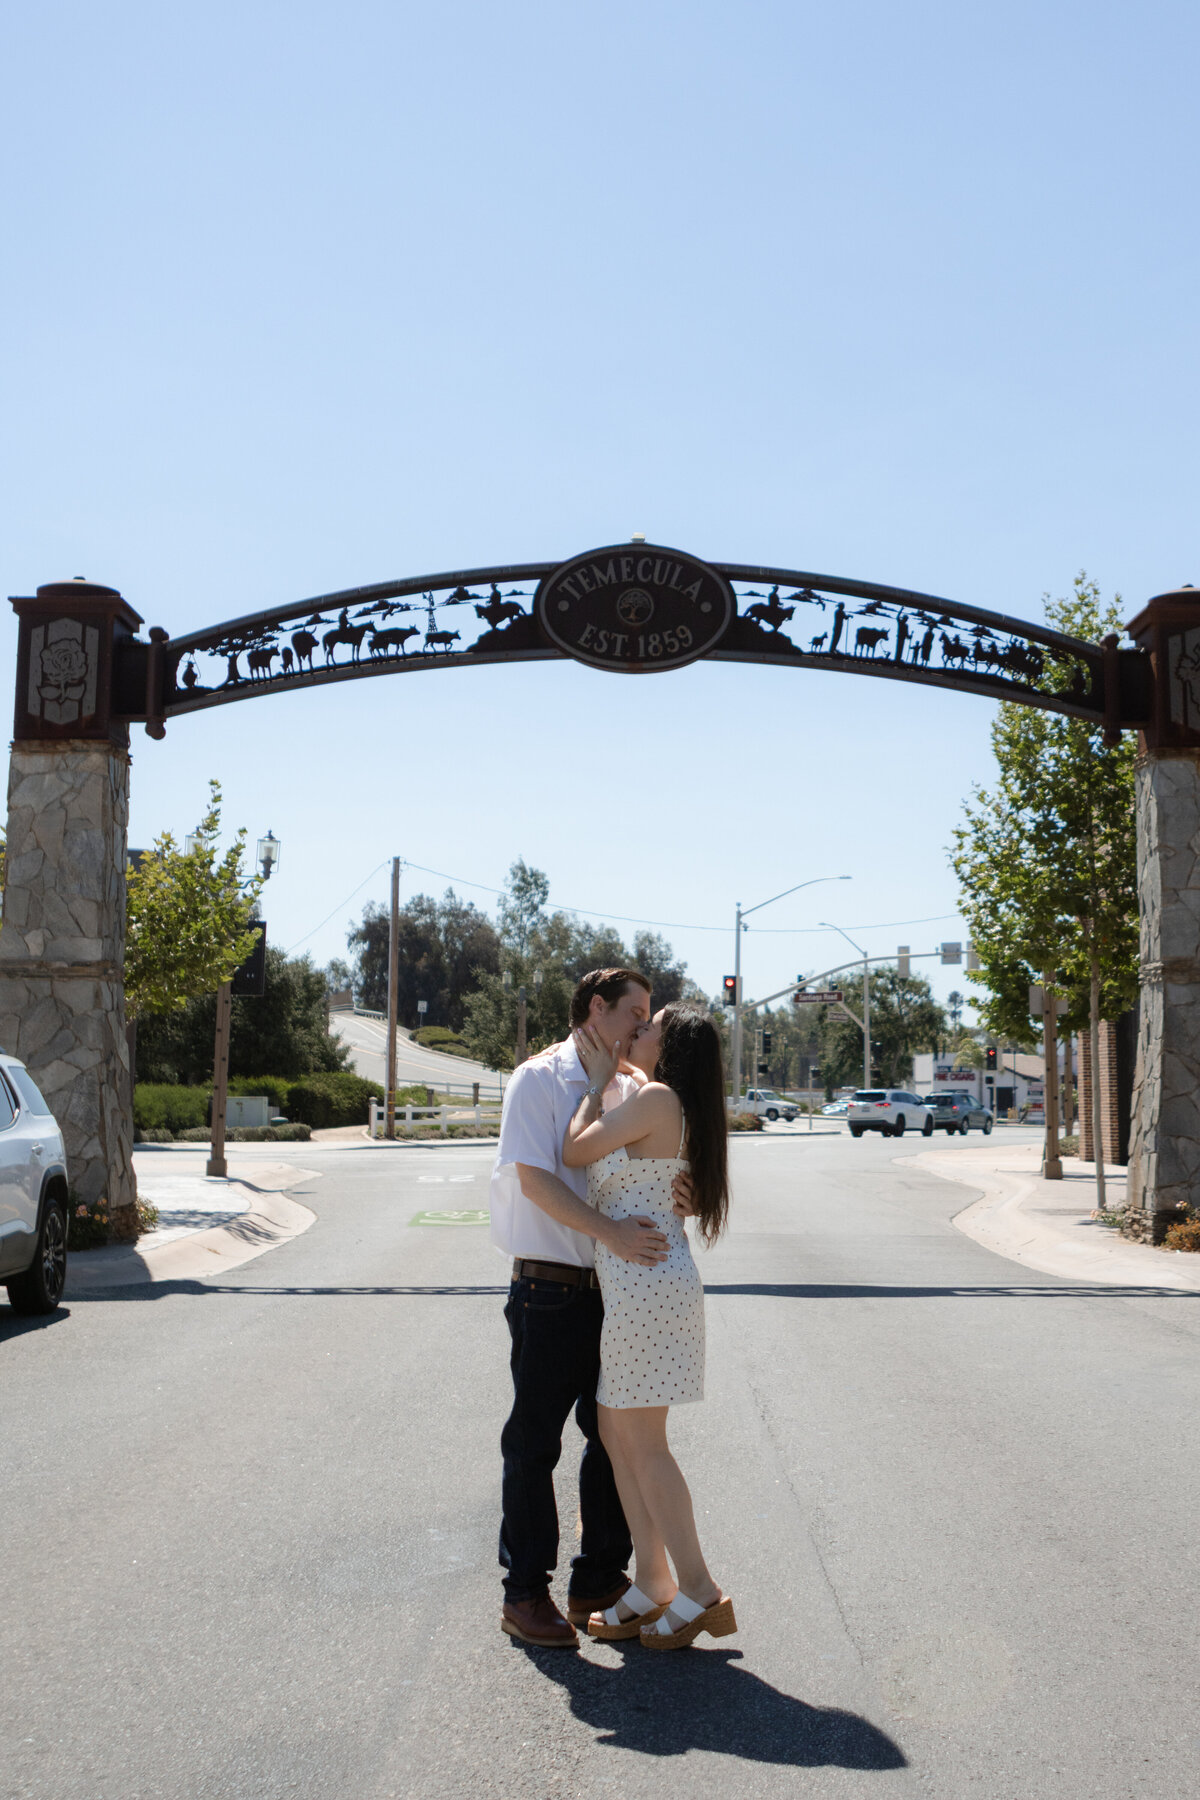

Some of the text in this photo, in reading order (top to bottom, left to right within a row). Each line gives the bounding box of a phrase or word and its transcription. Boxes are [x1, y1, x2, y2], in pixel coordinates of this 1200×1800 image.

[557, 557, 703, 602] TEMECULA
[638, 625, 693, 657] 1859
[950, 1073, 976, 1081] CIGARS
